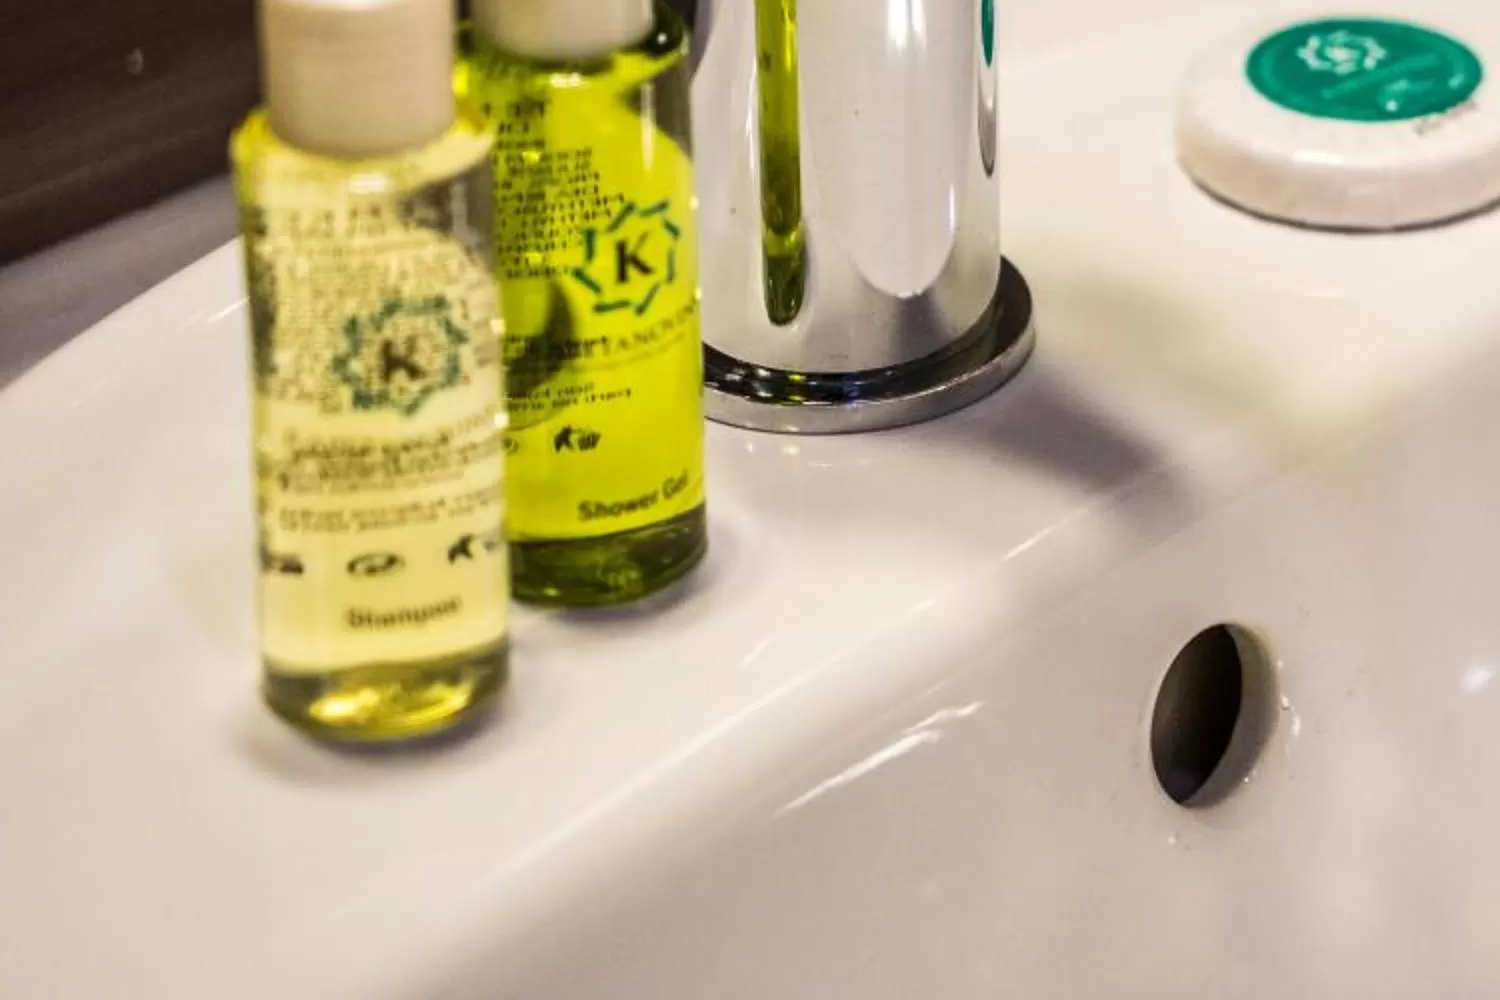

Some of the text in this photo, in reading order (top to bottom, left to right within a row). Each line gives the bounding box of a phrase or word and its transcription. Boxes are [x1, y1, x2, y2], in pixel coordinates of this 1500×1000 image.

[615, 232, 656, 285] K
[380, 335, 427, 384] K
[578, 466, 689, 521] Shower Gel
[344, 597, 461, 629] Shampoo
